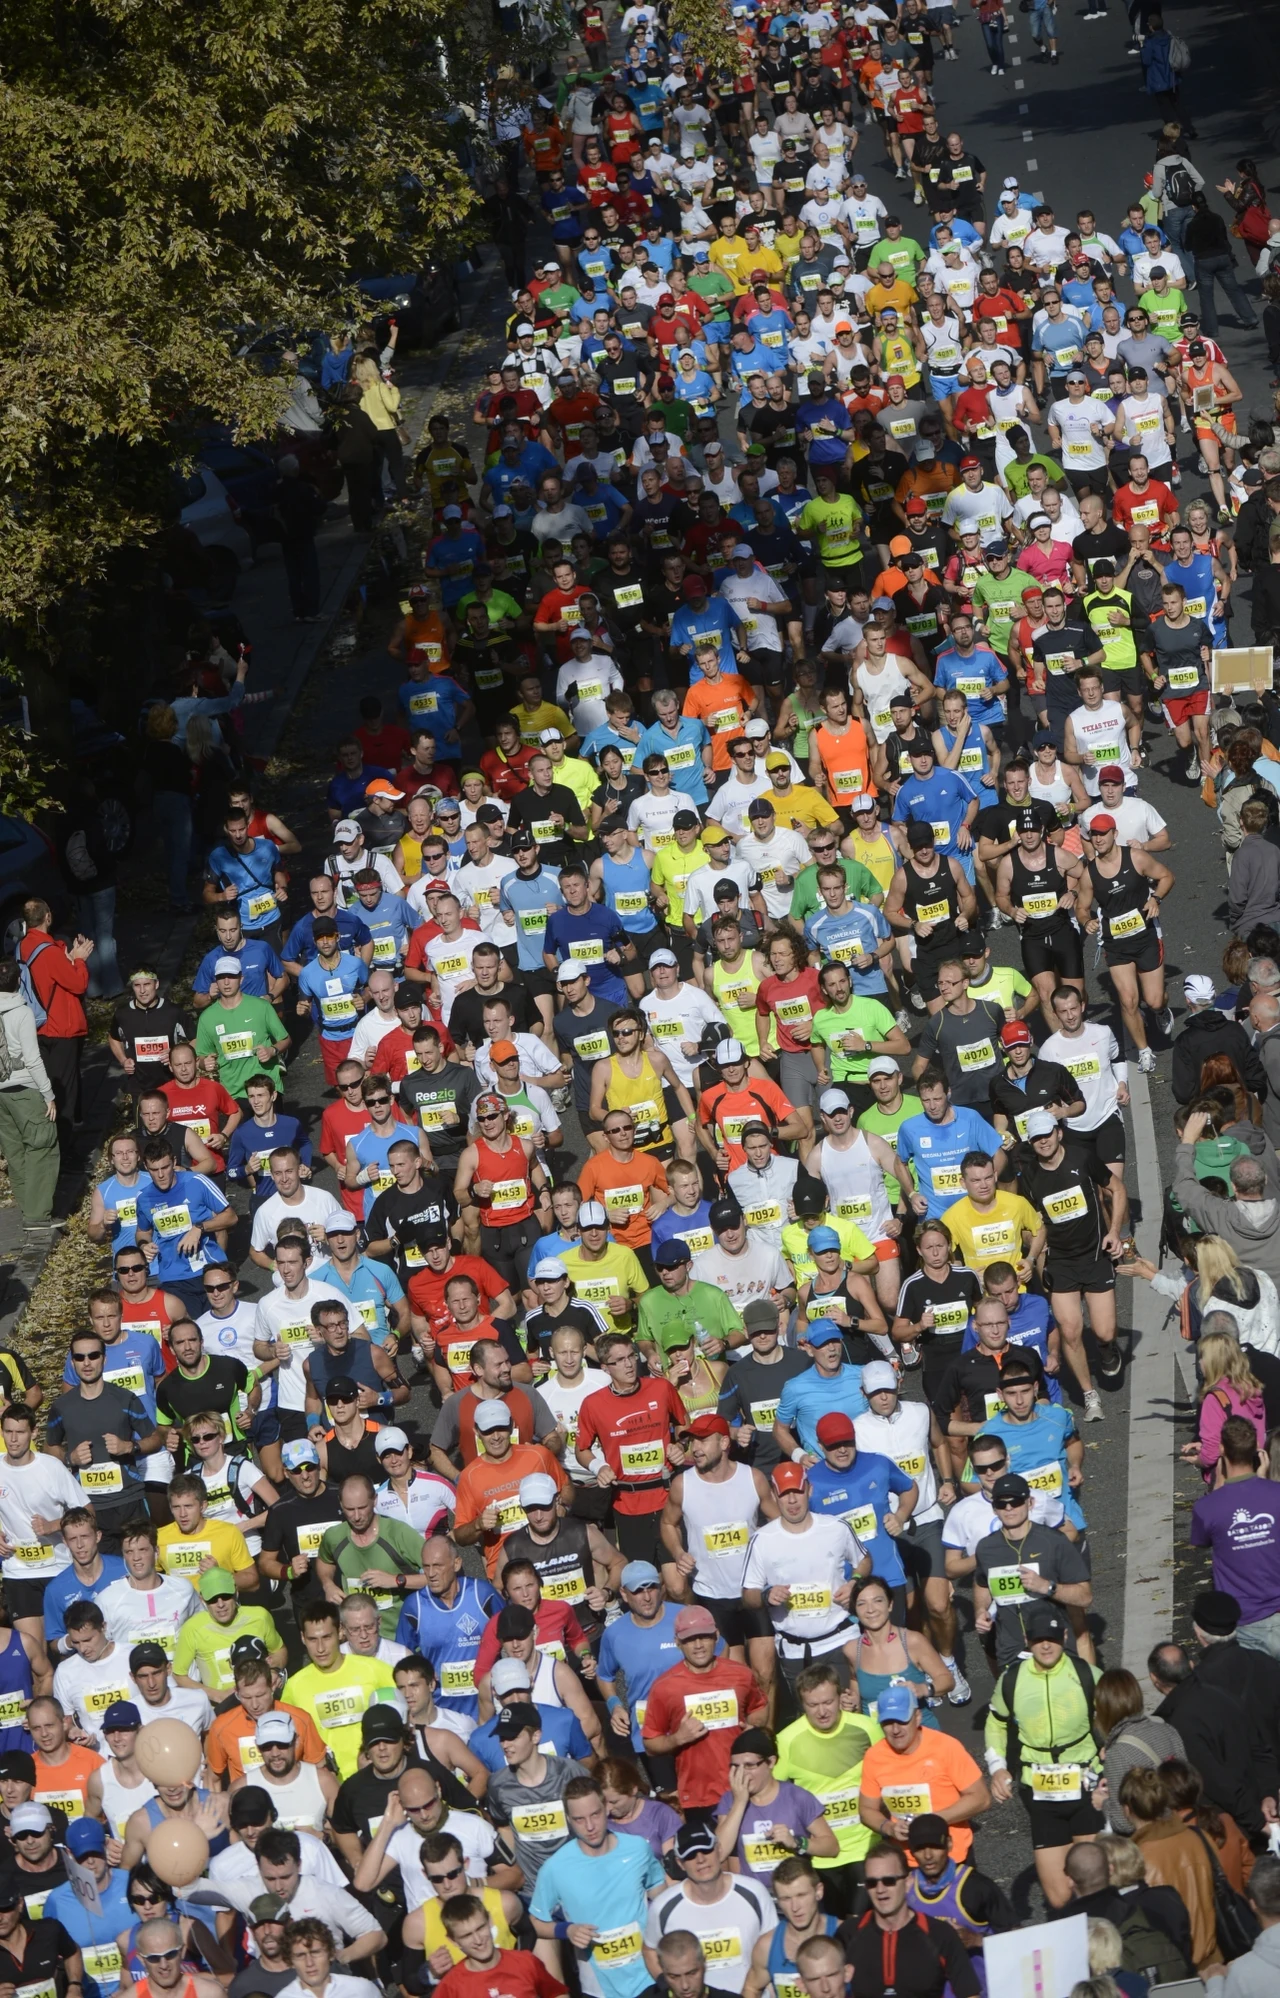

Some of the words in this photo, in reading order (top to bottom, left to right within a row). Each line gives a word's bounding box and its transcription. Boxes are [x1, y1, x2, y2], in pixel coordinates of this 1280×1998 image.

[1136, 510, 1154, 519] 6672
[1184, 603, 1203, 612] 4729
[1173, 671, 1194, 681] 4050
[961, 683, 982, 691] 2420
[1082, 723, 1102, 732] TEXAS
[1103, 719, 1118, 728] TECH
[670, 751, 692, 763] 5708
[1096, 749, 1115, 759] 8711
[838, 777, 858, 786] 4512
[620, 898, 642, 906] 7949
[1029, 899, 1052, 909] 5082
[923, 903, 944, 915] 3358
[1115, 918, 1138, 931] 4862
[576, 946, 597, 957] 7876
[441, 958, 461, 968] 7128
[327, 1001, 349, 1012] 6396
[782, 1004, 804, 1014] 8198
[656, 1024, 678, 1034] 6775
[141, 1043, 164, 1053] 6909
[580, 1041, 602, 1052] 4307
[964, 1048, 988, 1060] 4070
[611, 1194, 638, 1205] 4748
[1051, 1197, 1078, 1211] 6702
[750, 1207, 775, 1219] 7092
[841, 1202, 866, 1215] 8054
[159, 1214, 184, 1227] 3946
[981, 1231, 1008, 1243] 6676
[585, 1287, 611, 1299] 4331
[628, 1450, 658, 1463] 8422
[86, 1472, 114, 1483] 6704
[306, 1535, 323, 1545] 19
[712, 1532, 740, 1545] 7214
[20, 1548, 45, 1557] 3631
[176, 1552, 202, 1564] 3128
[549, 1581, 577, 1593] 3918
[791, 1592, 823, 1604] 1346
[92, 1691, 122, 1706] 6723
[325, 1698, 355, 1713] 3610
[695, 1701, 729, 1715] 4953
[1040, 1774, 1069, 1786] 7416
[891, 1796, 921, 1808] 3653
[522, 1814, 556, 1828] 2592
[601, 1936, 636, 1954] 6541
[785, 1985, 804, 1998] 56
